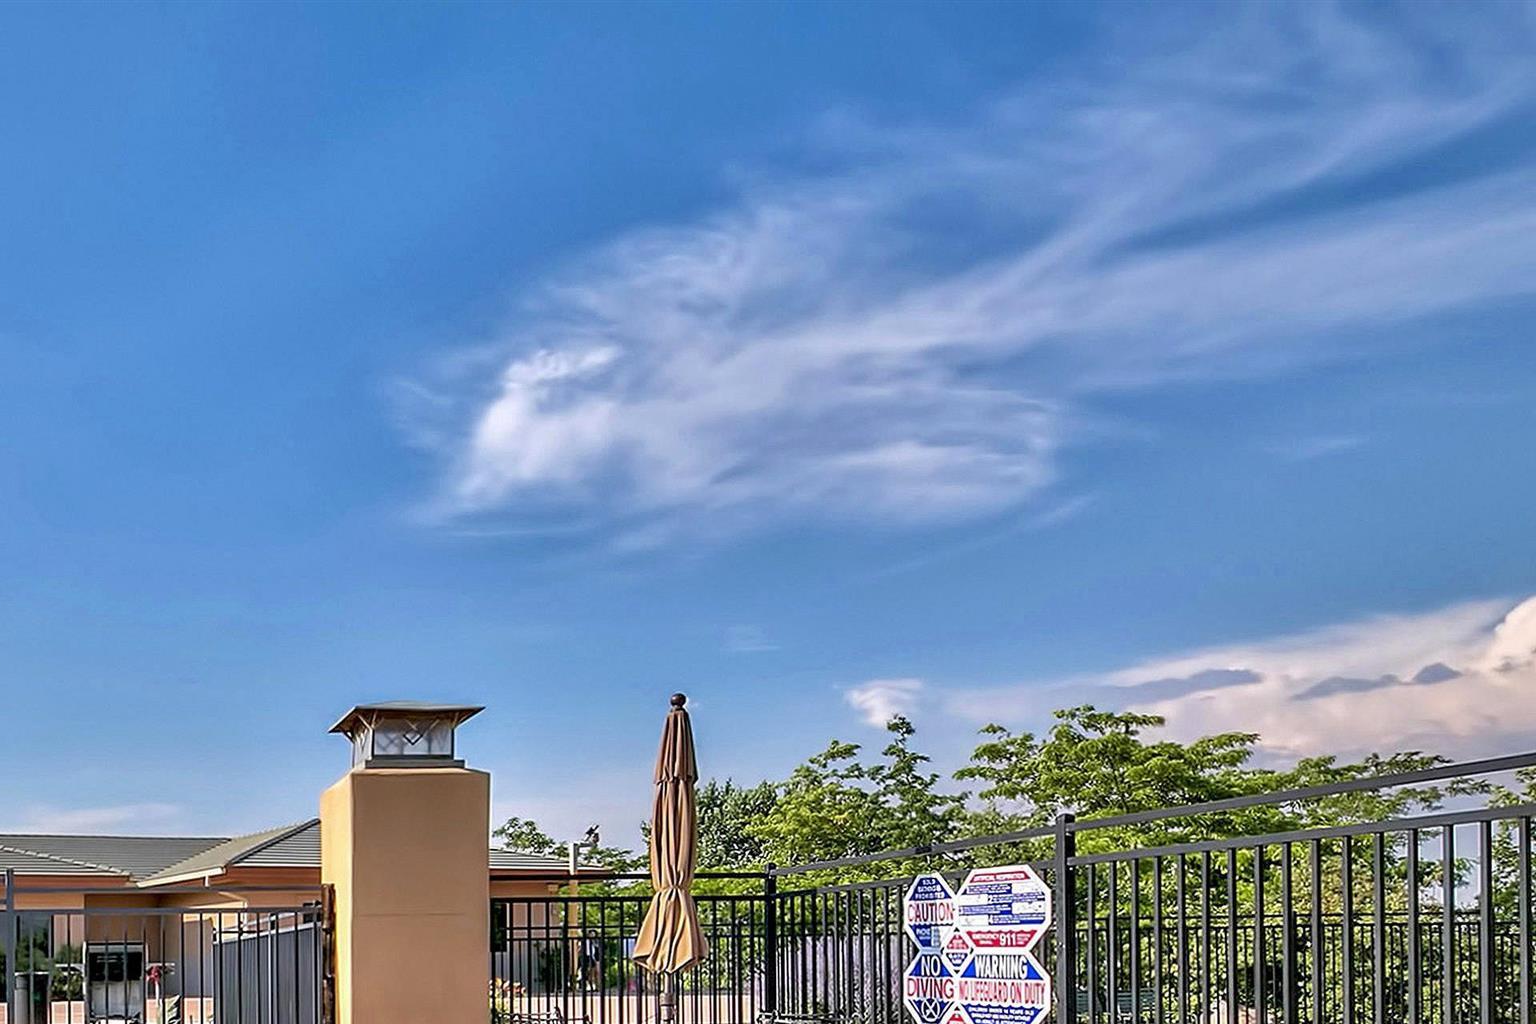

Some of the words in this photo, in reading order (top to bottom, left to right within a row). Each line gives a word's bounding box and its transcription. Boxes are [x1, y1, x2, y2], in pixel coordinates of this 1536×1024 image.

[908, 902, 954, 922] CAUTION
[999, 933, 1017, 946] 911
[921, 955, 941, 977] NO
[975, 955, 1028, 979] WARNING
[907, 978, 954, 999] DIVING
[959, 981, 969, 1000] NO
[971, 981, 1008, 1002] LIFEGUARD
[1010, 982, 1022, 1003] ON
[1025, 983, 1045, 1004] DUTY
